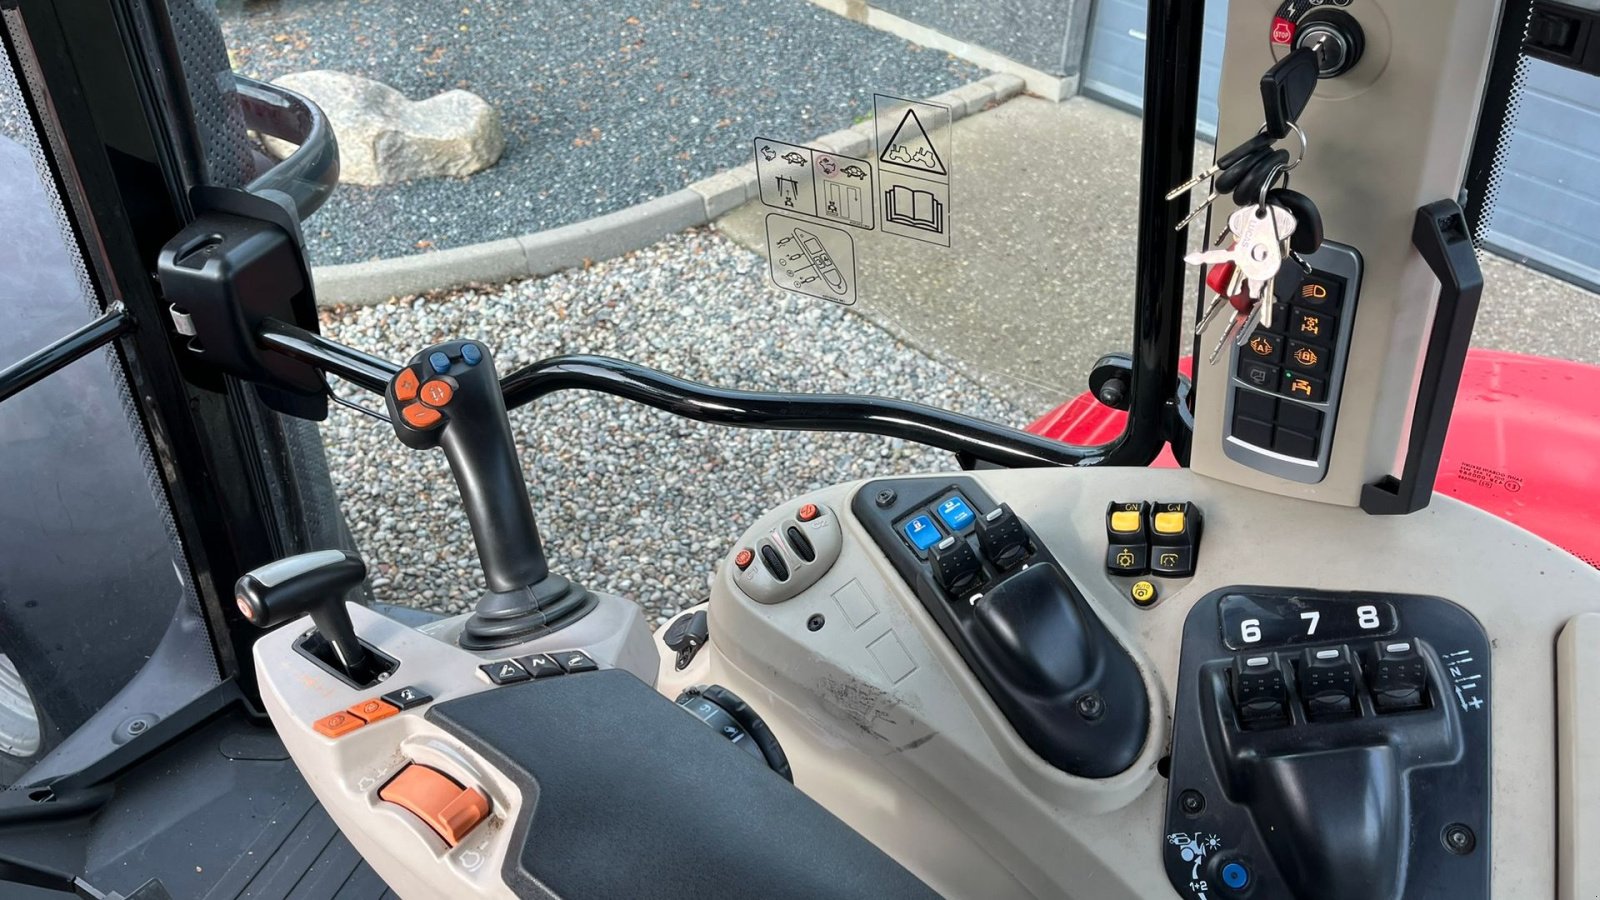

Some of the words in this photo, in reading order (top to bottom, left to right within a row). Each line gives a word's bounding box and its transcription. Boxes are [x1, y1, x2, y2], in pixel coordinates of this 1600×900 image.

[1242, 219, 1257, 248] LUCAS
[1125, 503, 1138, 511] ON
[1167, 503, 1181, 511] ON
[1135, 581, 1151, 589] AUTO
[1240, 618, 1262, 643] 6
[1300, 611, 1320, 635] 7
[1356, 605, 1380, 629] 8
